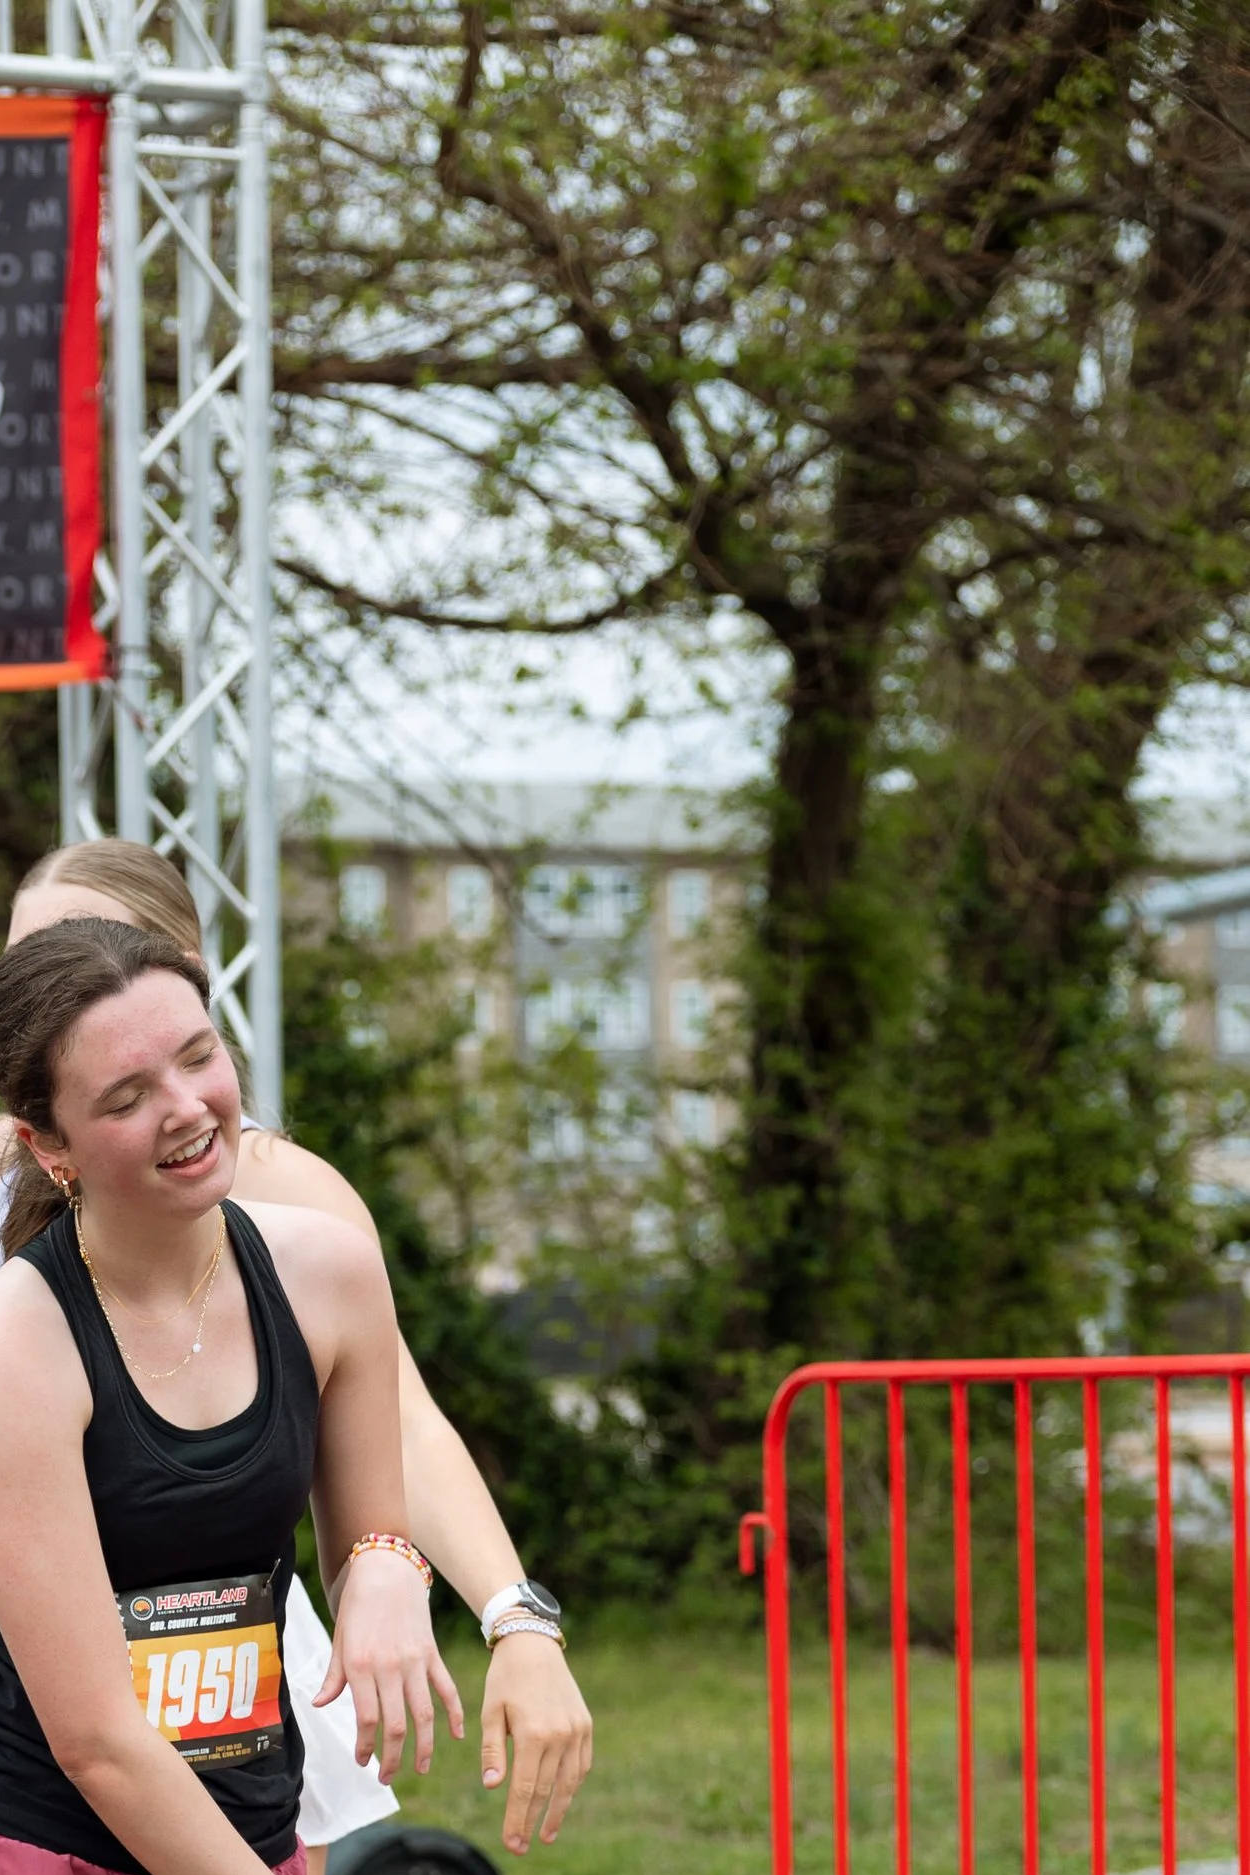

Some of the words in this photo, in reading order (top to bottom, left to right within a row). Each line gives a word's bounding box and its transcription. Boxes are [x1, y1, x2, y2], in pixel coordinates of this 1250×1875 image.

[156, 1586, 248, 1610] HEARTLAND
[150, 1620, 166, 1632] GOD.
[167, 1617, 199, 1630] COUNTRY.
[146, 1641, 259, 1729] 1950
